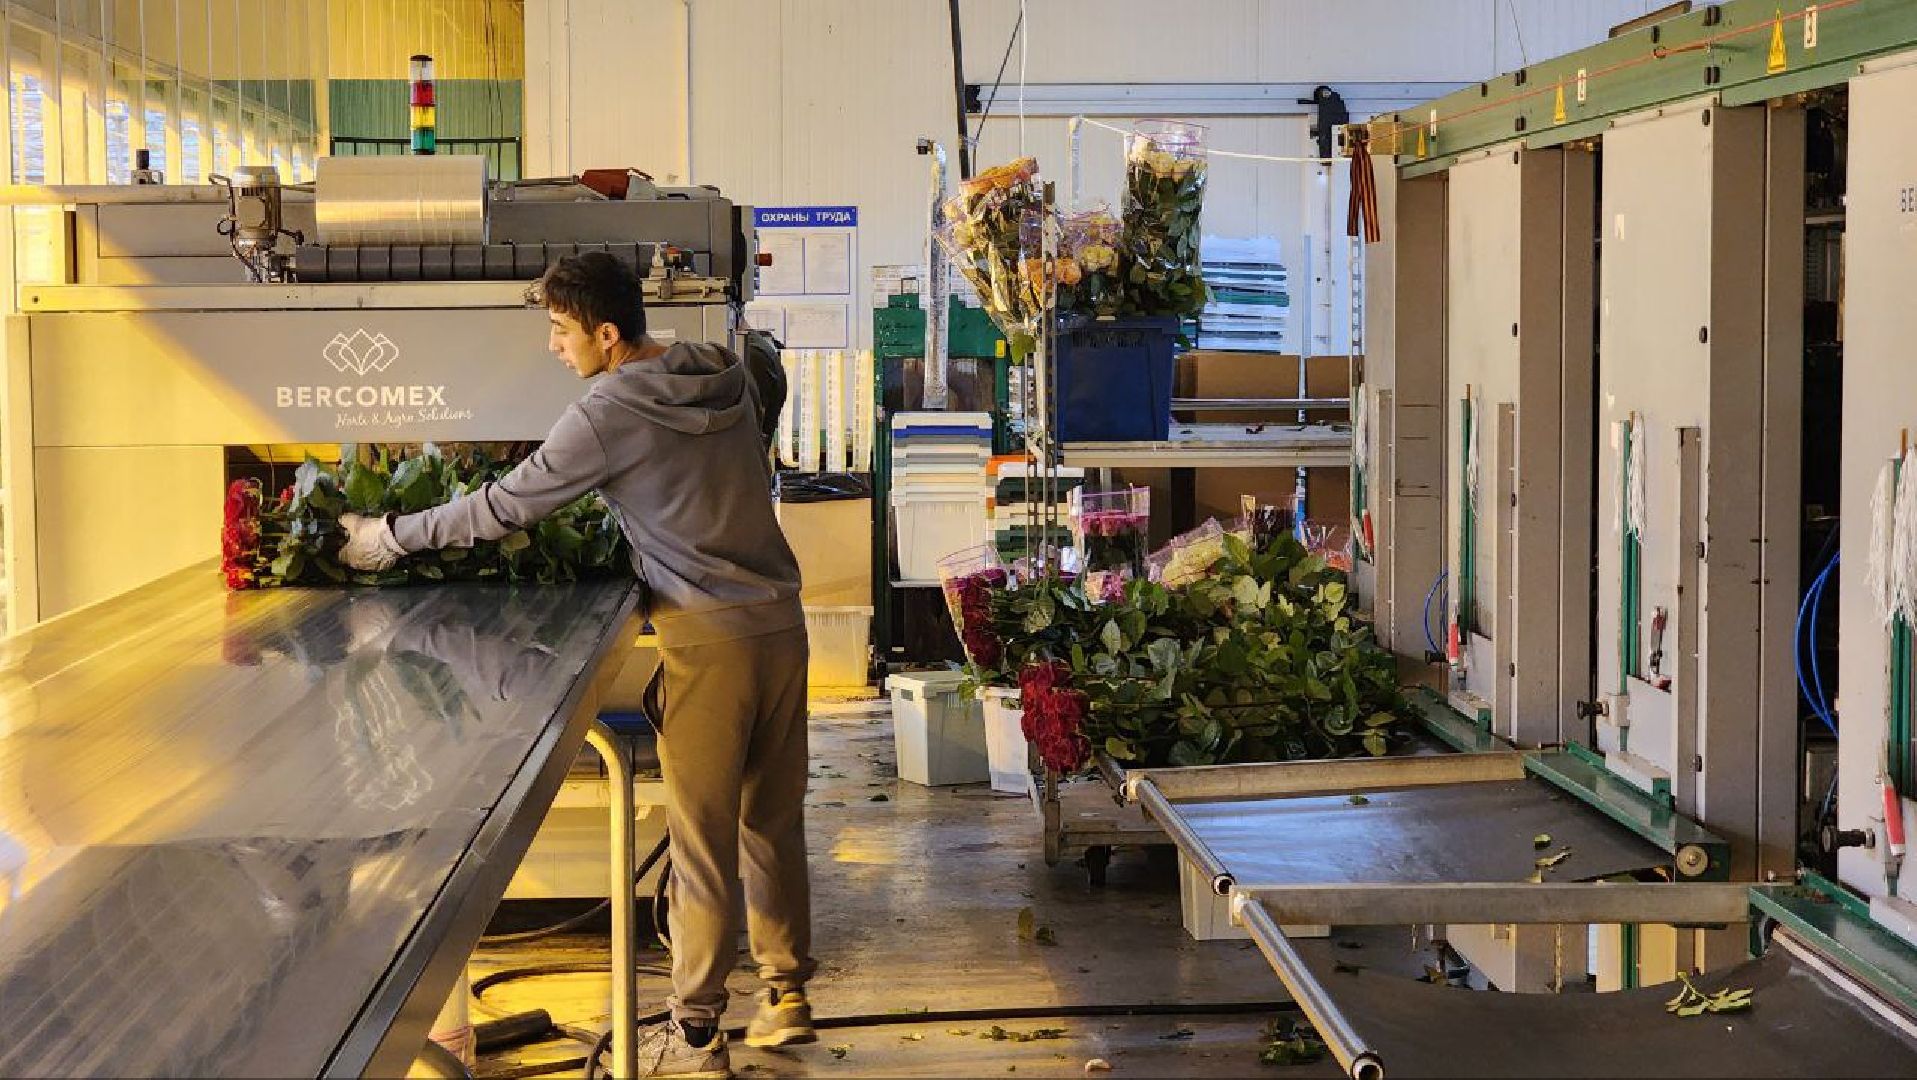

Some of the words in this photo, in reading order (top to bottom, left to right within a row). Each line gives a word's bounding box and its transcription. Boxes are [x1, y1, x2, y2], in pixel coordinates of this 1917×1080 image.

[1901, 187, 1917, 212] BE
[761, 213, 809, 222] ОХРАНЫ
[815, 211, 851, 223] ТРУДА
[275, 385, 447, 408] BERCOMEX
[371, 412, 379, 424] &
[381, 409, 415, 428] Agro
[418, 406, 474, 422] Solutions
